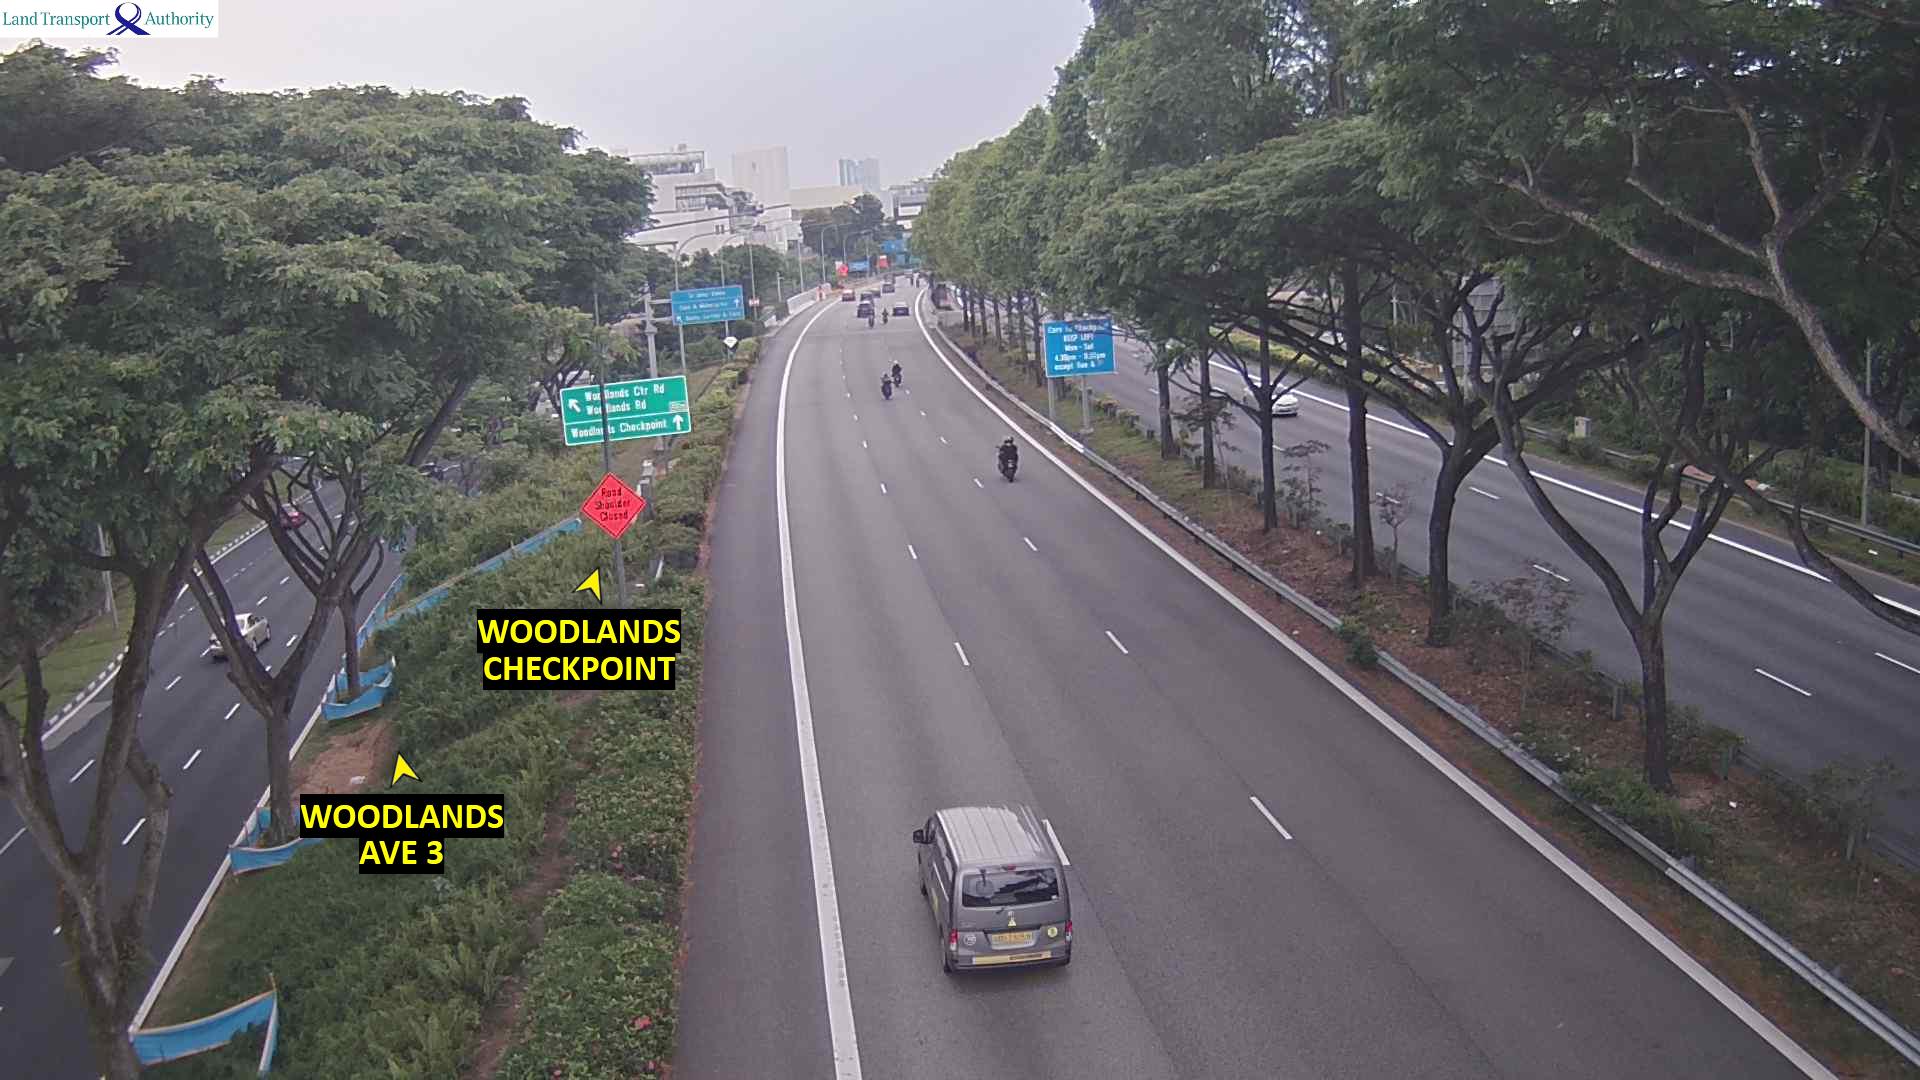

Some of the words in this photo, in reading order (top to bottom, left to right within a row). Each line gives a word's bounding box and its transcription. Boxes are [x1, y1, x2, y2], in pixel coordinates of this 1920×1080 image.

[1080, 332, 1094, 341] LEFT
[585, 389, 629, 401] Woolands
[633, 386, 648, 397] Ctr
[653, 383, 665, 394] Rd
[586, 402, 630, 415] Woolands
[634, 400, 647, 410] Rd
[619, 419, 667, 433] Checkpoint
[601, 487, 622, 497] Road
[595, 500, 630, 510] Shoulder
[600, 509, 629, 521] Closed
